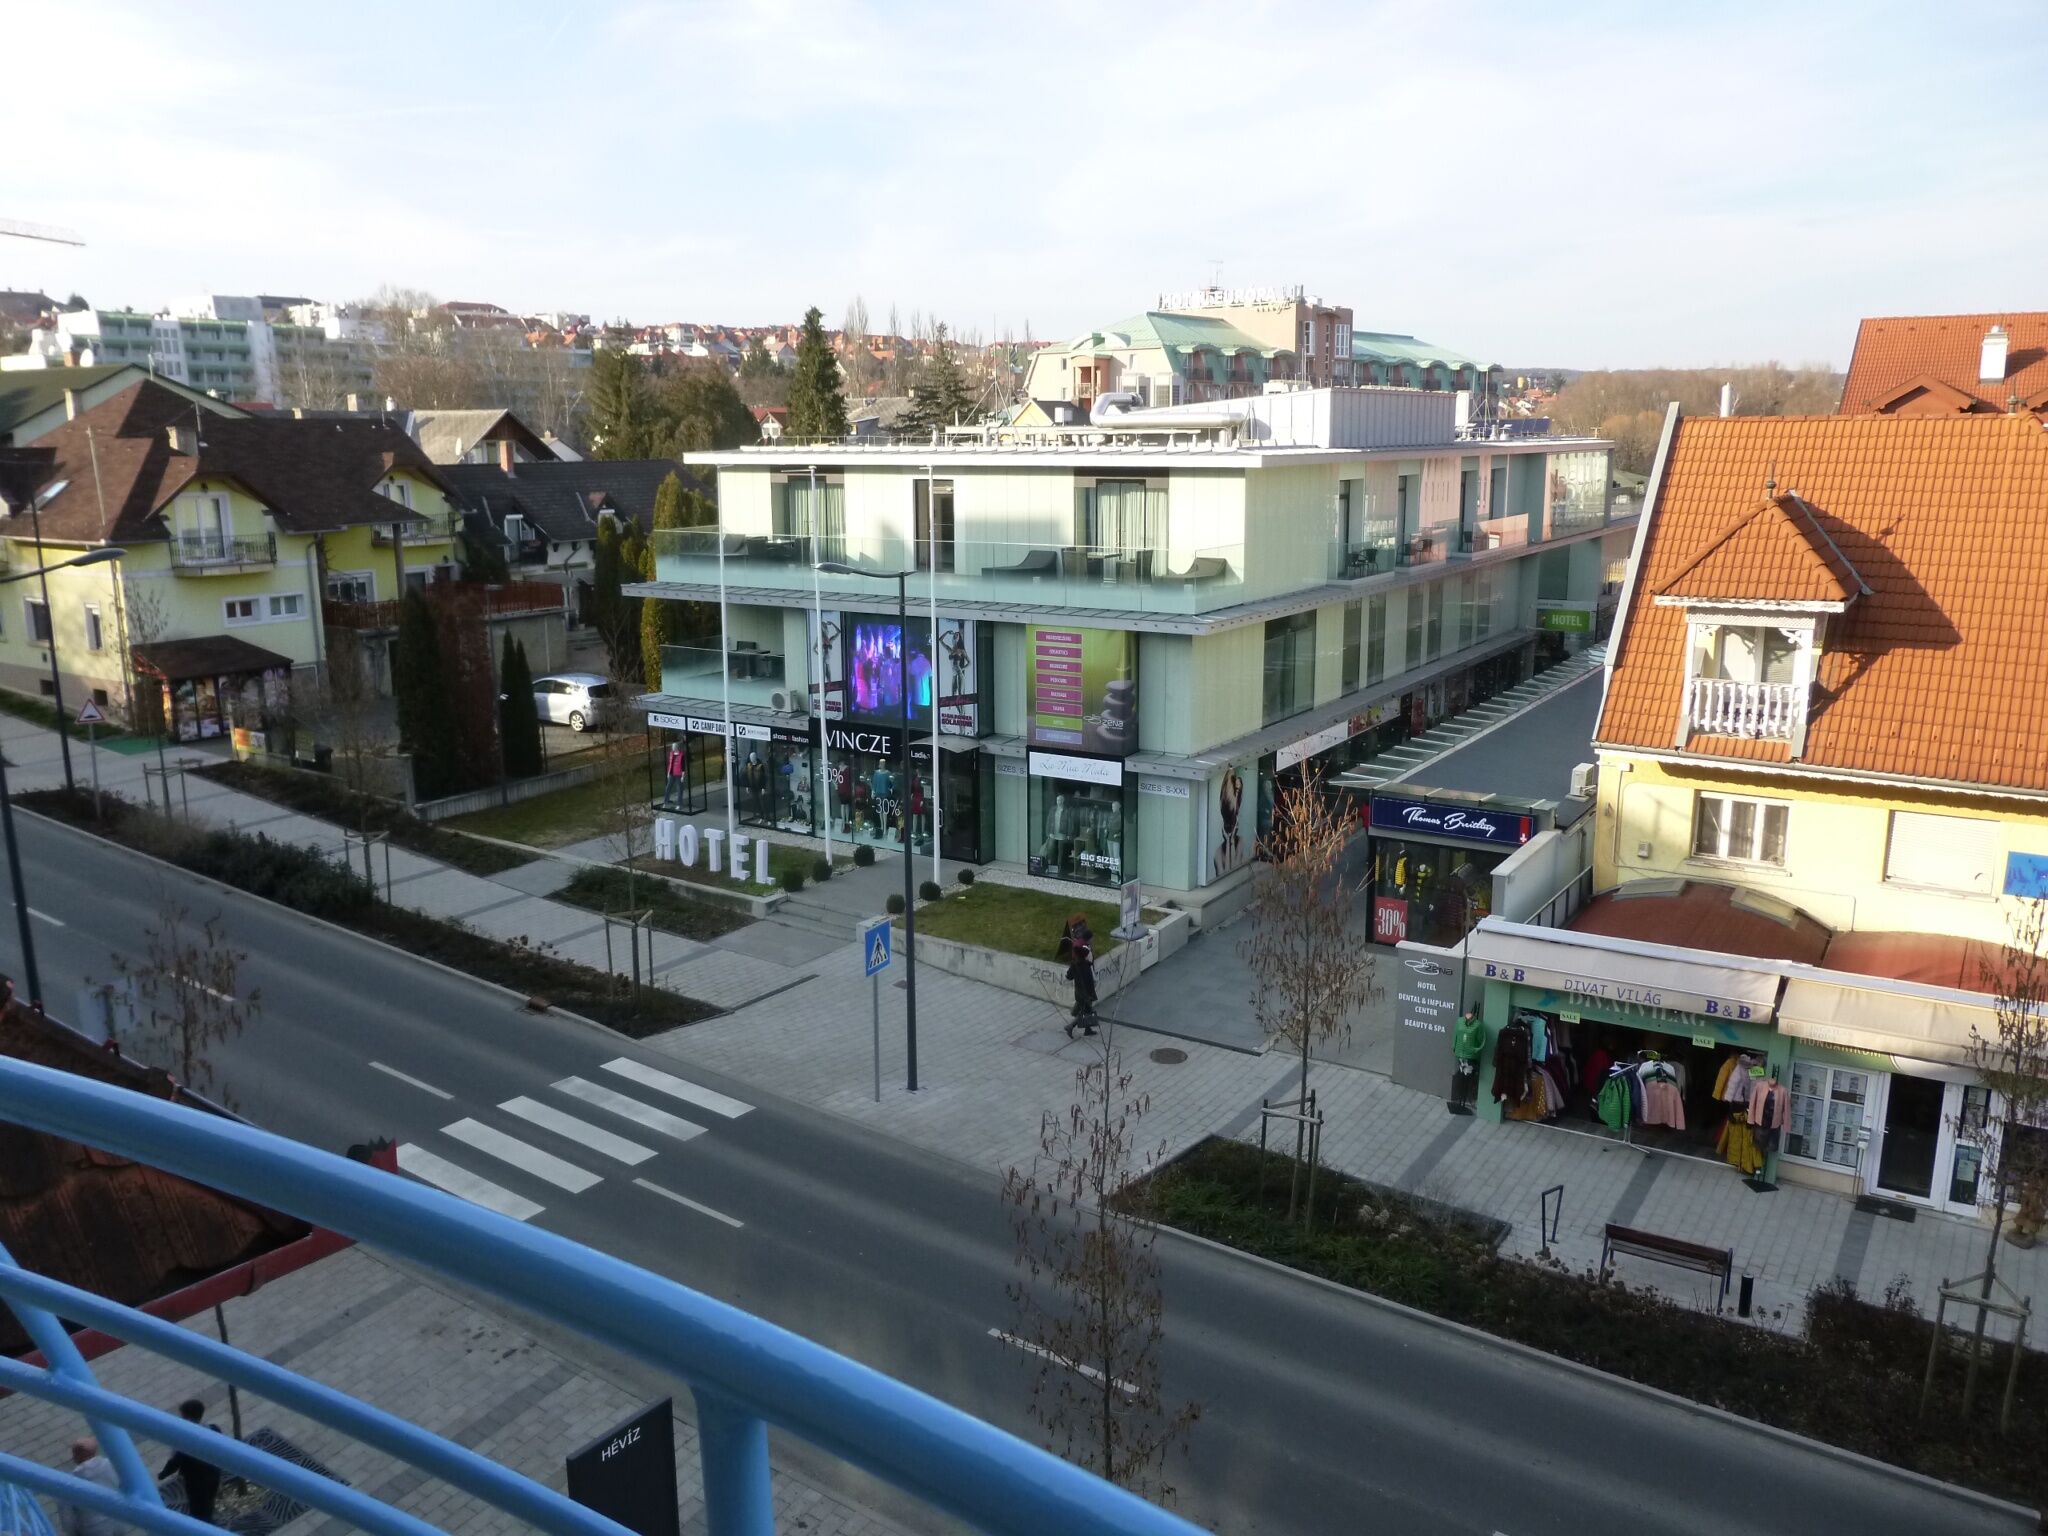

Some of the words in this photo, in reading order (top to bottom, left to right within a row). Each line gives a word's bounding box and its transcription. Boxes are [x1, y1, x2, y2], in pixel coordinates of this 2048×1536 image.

[1551, 614, 1582, 627] HOTEL
[772, 733, 787, 741] shoes
[791, 735, 809, 744] fashion
[825, 729, 891, 755] VINCZE
[1402, 807, 1441, 824] Thomas
[655, 818, 776, 885] HOTEL
[1080, 853, 1095, 862] BIG
[1096, 855, 1120, 865] SIZES
[1417, 981, 1436, 991] HOTEL
[1564, 979, 1608, 997] DIVAT
[1616, 985, 1662, 1006] VILÁG
[1398, 993, 1421, 1004] DENTAL
[1427, 998, 1454, 1010] IMPLANT
[1415, 1005, 1438, 1016] CENTER
[1561, 1013, 1578, 1021] SALE
[1404, 1018, 1428, 1031] BEAUTY
[1434, 1024, 1446, 1033] SPA
[1694, 1037, 1712, 1046] SALE
[601, 1427, 641, 1462] HÉVÍZ
